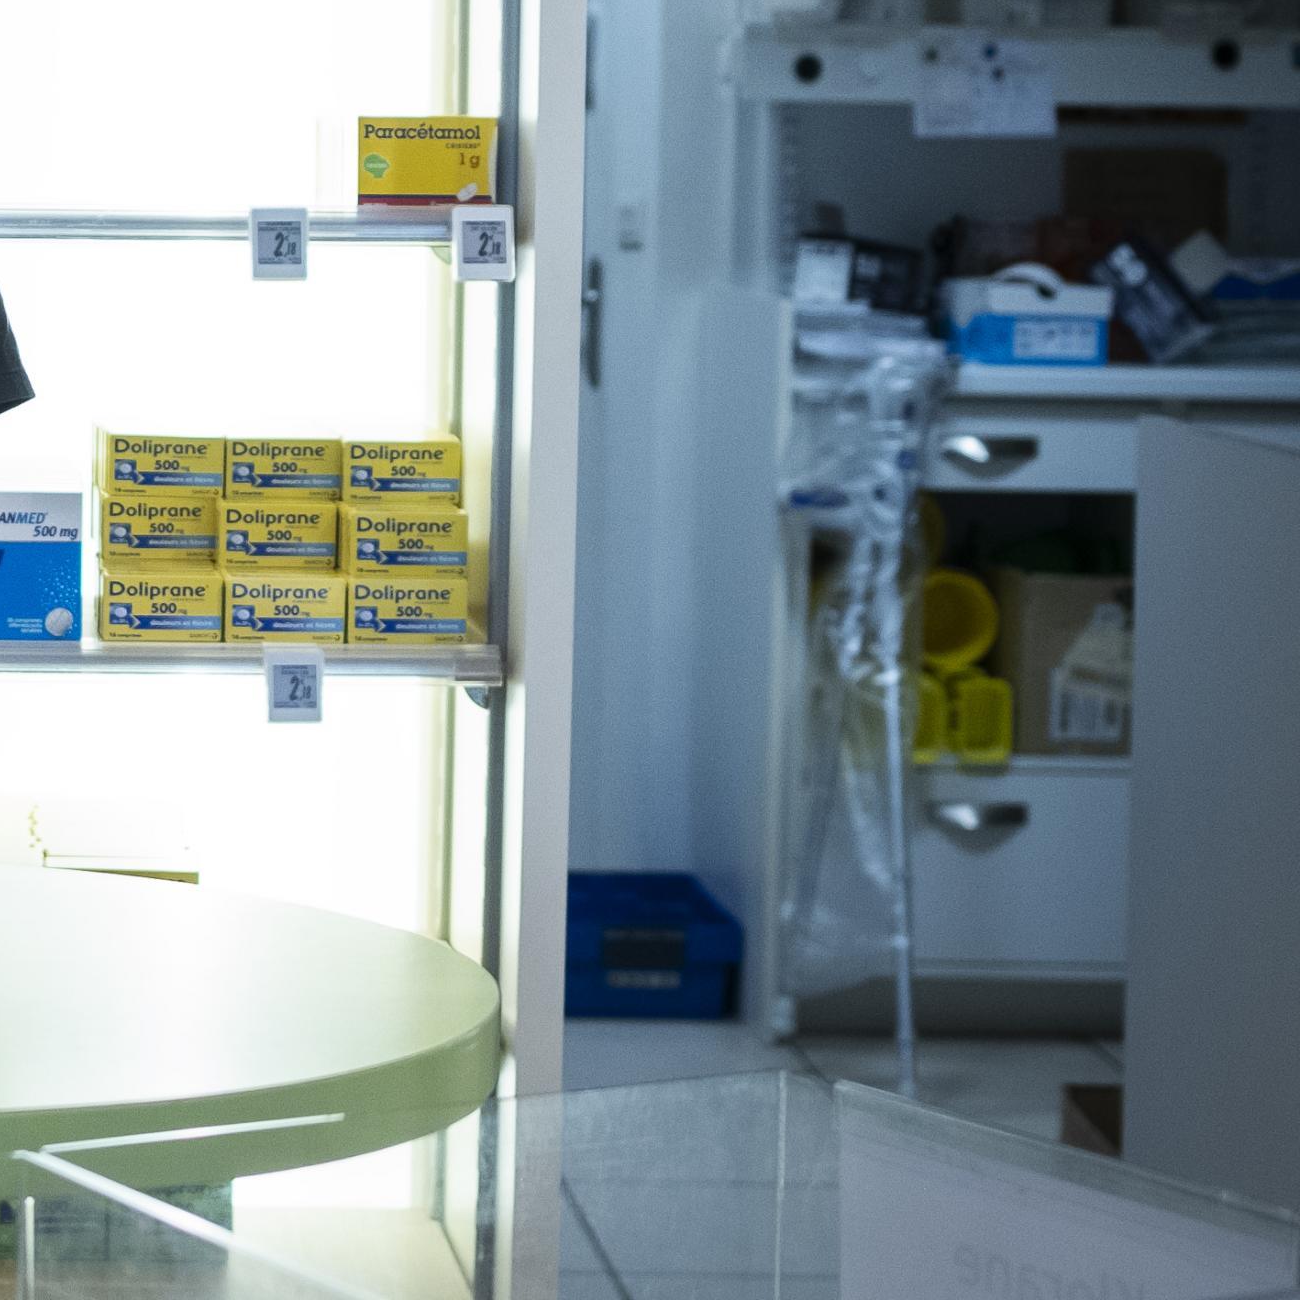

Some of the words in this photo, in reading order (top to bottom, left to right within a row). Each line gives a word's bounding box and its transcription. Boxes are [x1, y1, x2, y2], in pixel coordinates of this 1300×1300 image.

[364, 123, 481, 140] Paracétamol
[459, 153, 465, 166] 1
[470, 155, 481, 168] g
[114, 439, 207, 457] Doliprane
[232, 442, 325, 459] Doliprane
[351, 445, 444, 463] Doliprane
[155, 460, 179, 470] 500
[272, 463, 297, 472] 500
[391, 466, 416, 476] 500
[109, 502, 202, 520] Doliprane
[226, 509, 320, 527] Doliprane
[33, 525, 57, 537] 500
[60, 528, 78, 540] mg
[150, 523, 174, 533] 500
[357, 517, 452, 536] Doliprane
[267, 531, 292, 540] 500
[398, 539, 423, 550] 500
[109, 581, 206, 600] Doliprane
[232, 583, 328, 602] Doliprane
[355, 585, 450, 603] Doliprane
[151, 603, 177, 613] 500
[274, 605, 300, 616] 500
[397, 606, 422, 617] 500
